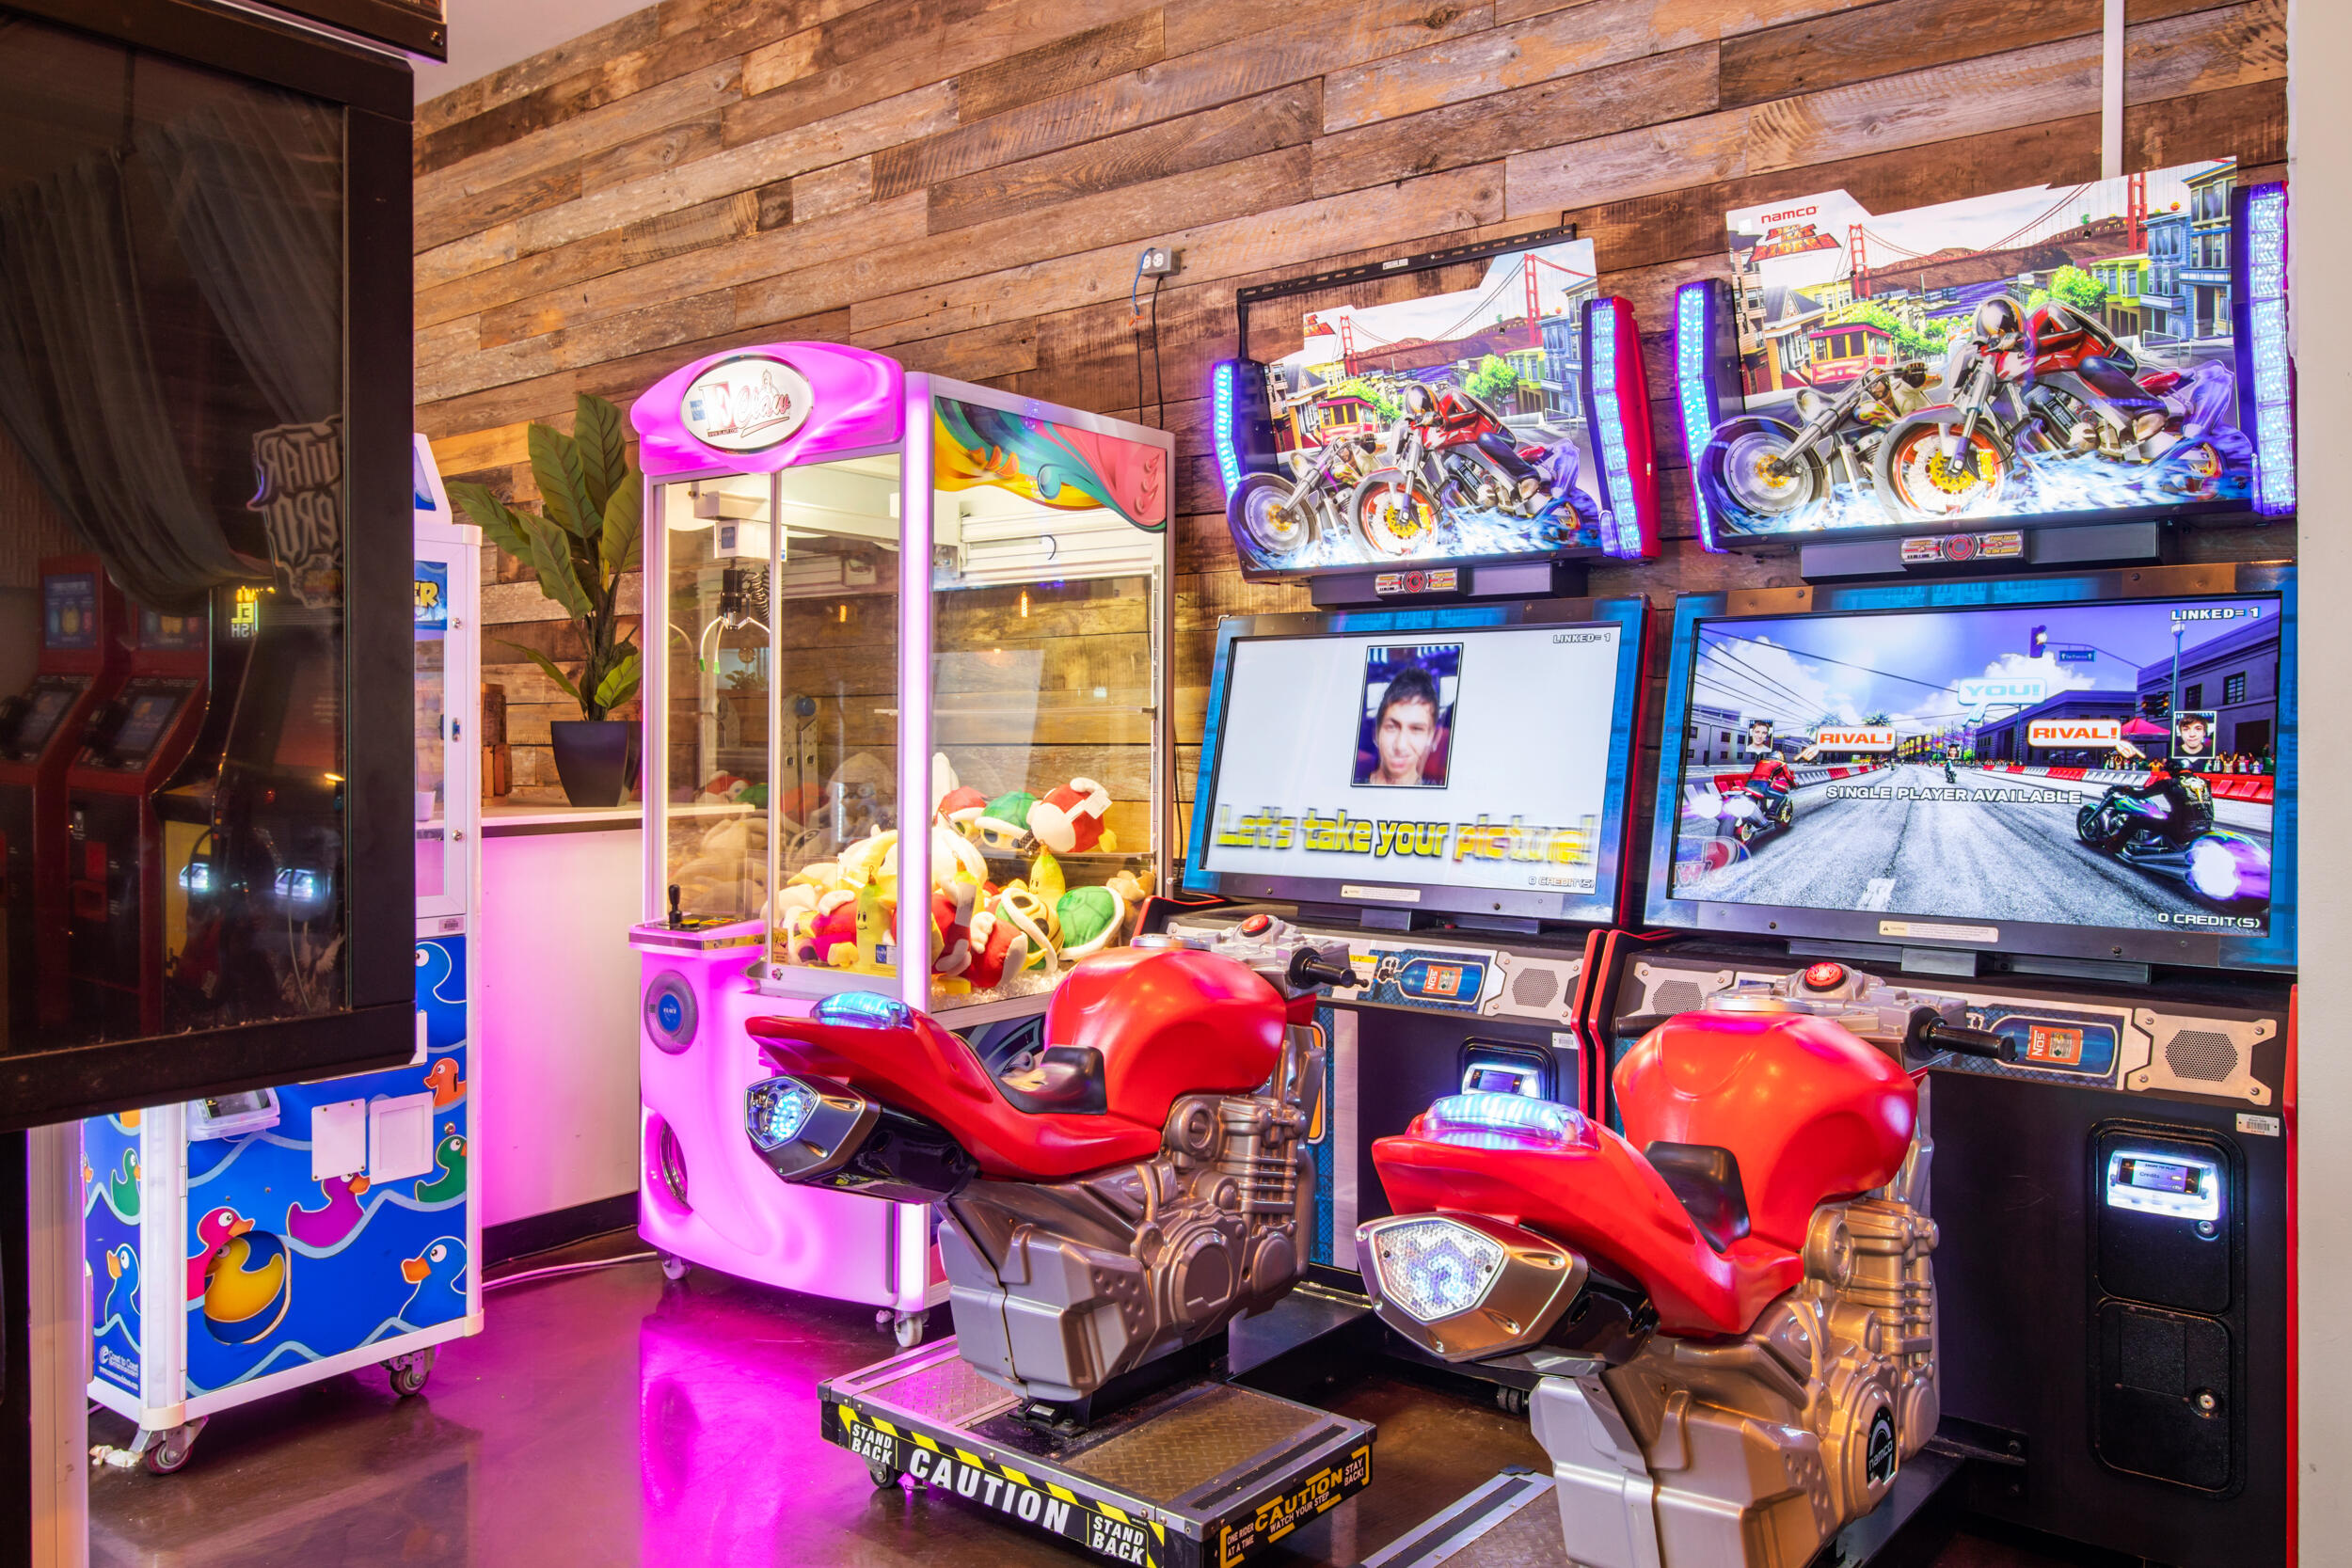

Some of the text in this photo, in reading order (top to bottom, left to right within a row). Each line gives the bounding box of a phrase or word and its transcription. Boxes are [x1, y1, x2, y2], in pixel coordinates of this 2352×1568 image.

[1761, 206, 1817, 224] namco
[1750, 233, 1841, 262] RIDERS
[2171, 607, 2259, 621] LINKED= 1
[1553, 633, 1611, 643] LINKED= 1
[1965, 683, 2041, 697] YOU!
[1819, 732, 1893, 745] RIVAL!
[2032, 725, 2118, 740] RIVAL!
[1826, 785, 2083, 805] SINGLE PLAYER AVAILABLE
[1216, 804, 1294, 848] Let's
[1302, 808, 1373, 853] take
[1375, 819, 1449, 857] your
[2158, 912, 2261, 928] 0 CREDIT(S)
[1426, 969, 1438, 990] NOS
[2031, 1030, 2045, 1056] NOS
[851, 1423, 893, 1449] STAND
[851, 1437, 893, 1465] BACK
[1868, 1439, 1893, 1471] namco
[1343, 1467, 1364, 1487] BACK!
[1344, 1458, 1363, 1476] STAY
[909, 1449, 1071, 1534] CAUTION
[1254, 1468, 1343, 1532] CAUTION
[1270, 1491, 1329, 1534] WATCH YOUR STEP
[1093, 1515, 1144, 1545] STAND
[1227, 1522, 1254, 1545] ONE RIDER
[1092, 1531, 1144, 1565] BACK
[1227, 1534, 1254, 1558] AT A TIME
